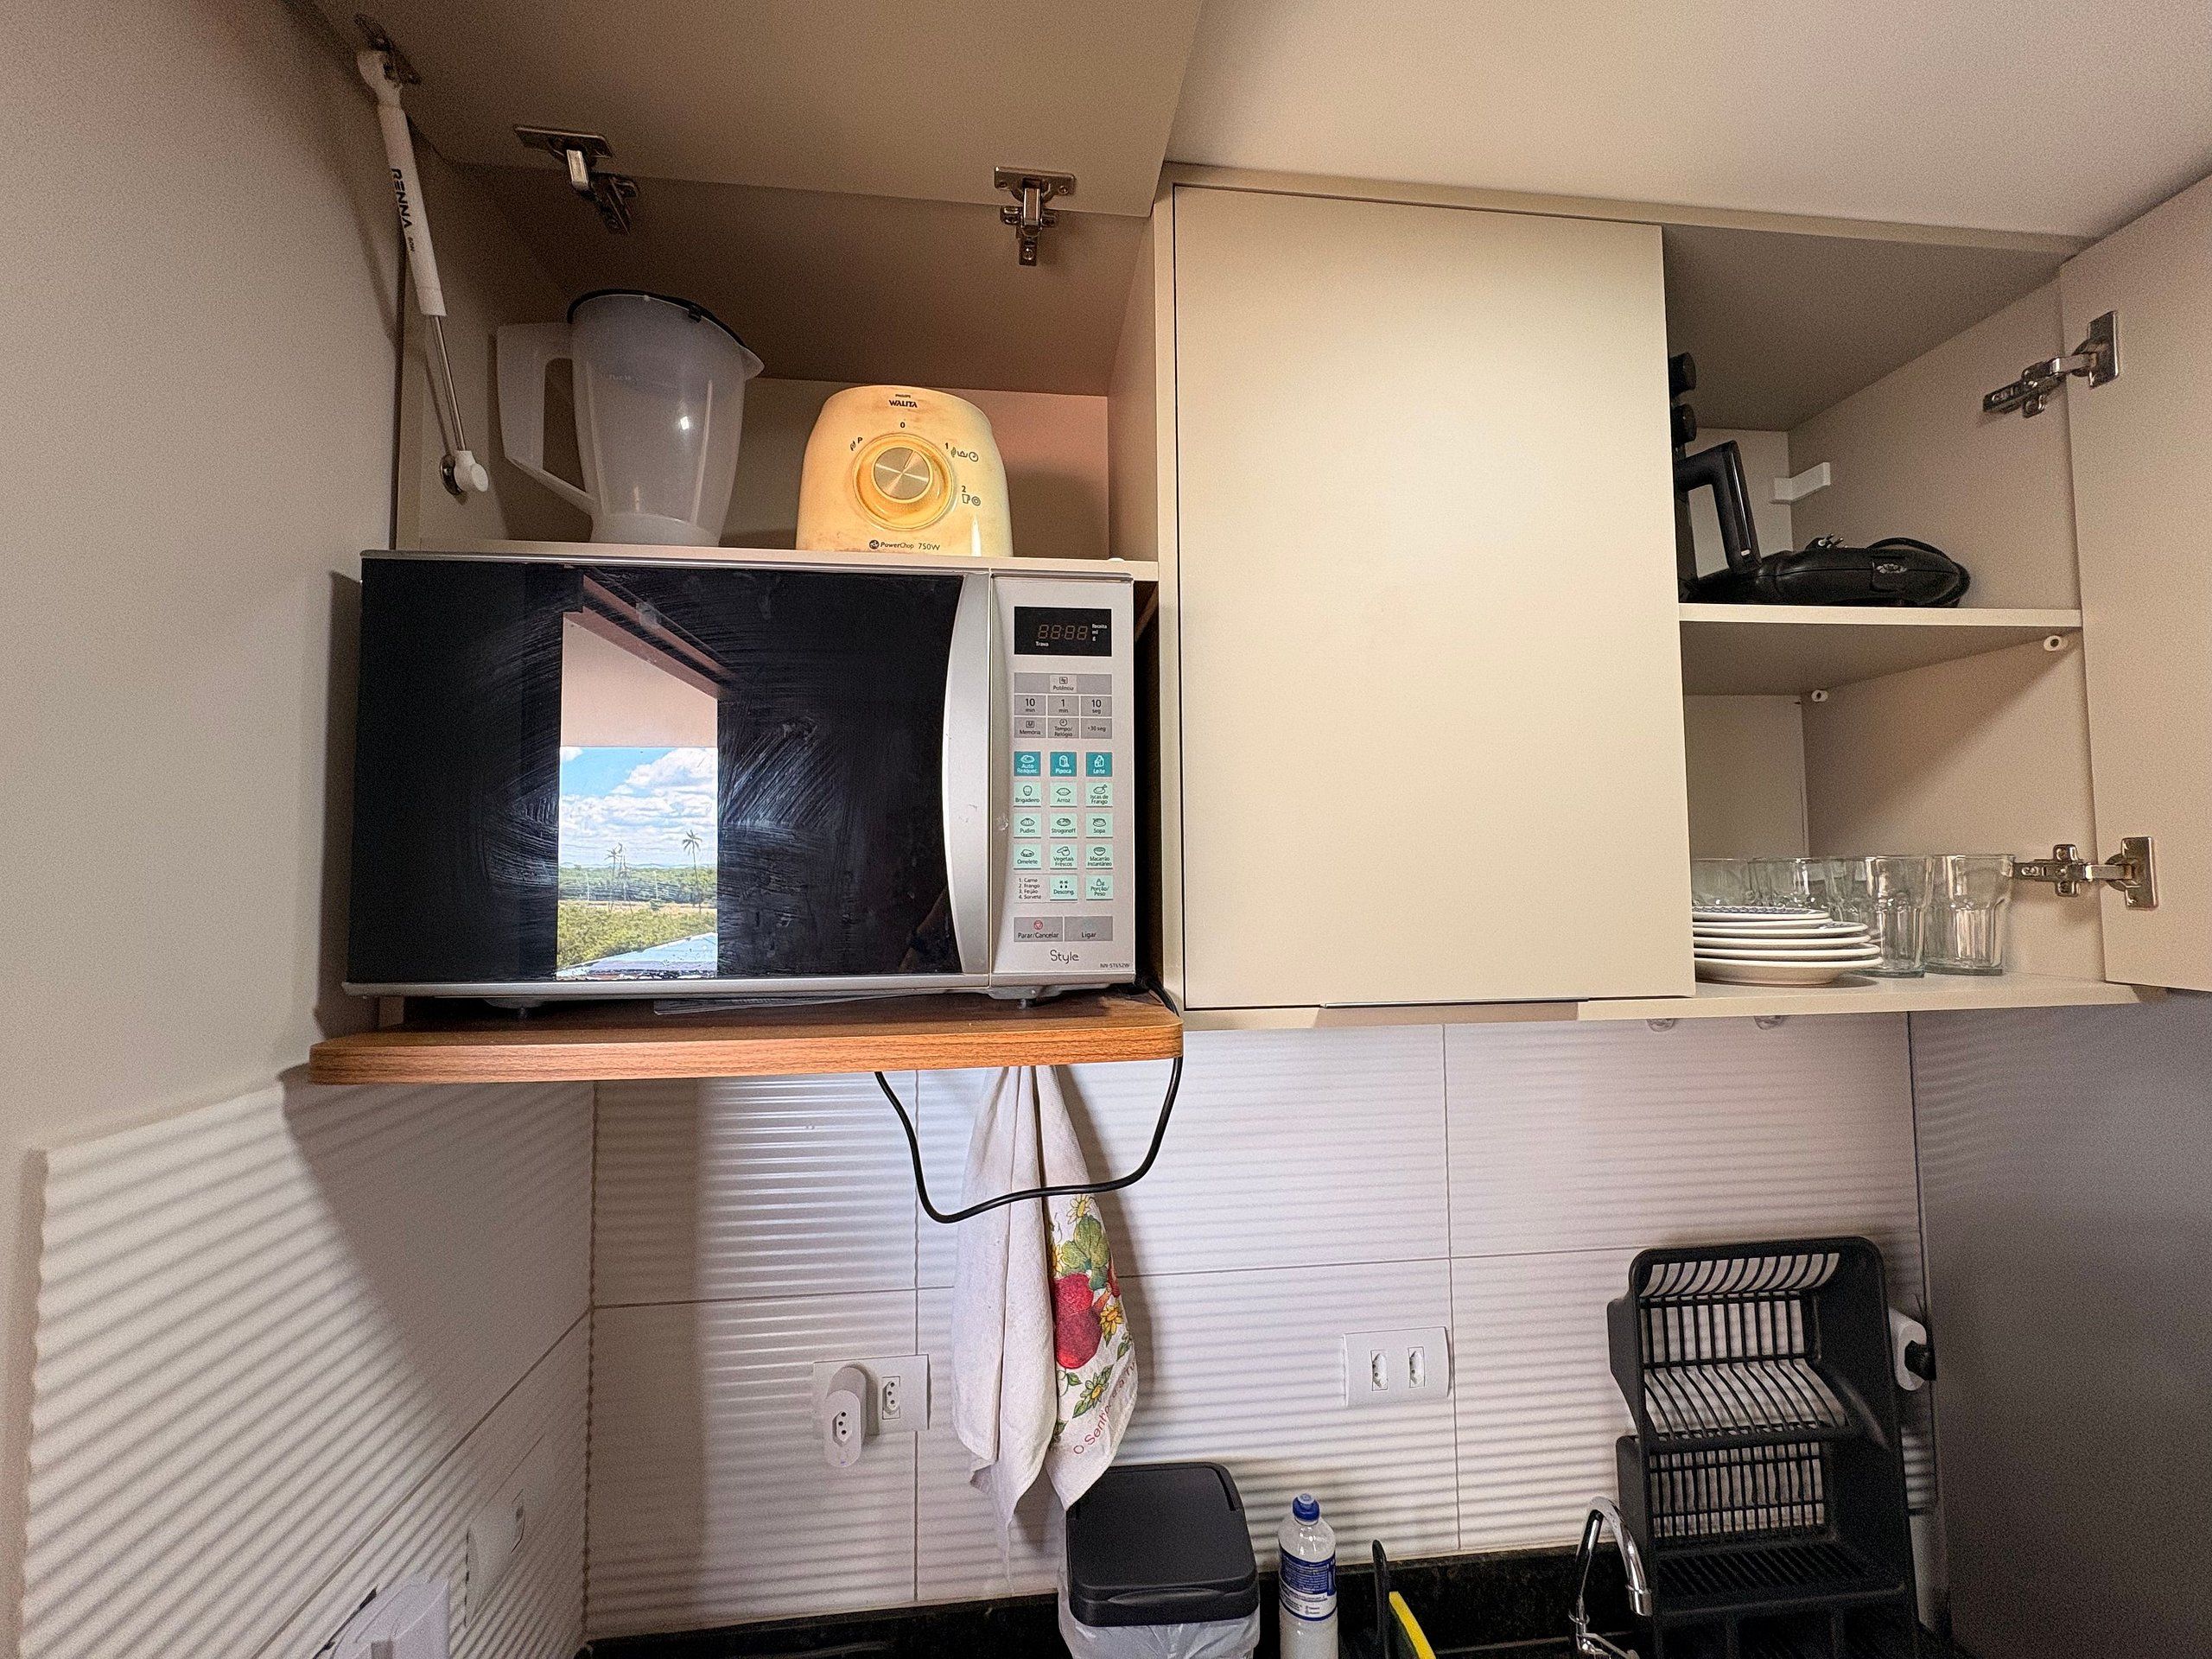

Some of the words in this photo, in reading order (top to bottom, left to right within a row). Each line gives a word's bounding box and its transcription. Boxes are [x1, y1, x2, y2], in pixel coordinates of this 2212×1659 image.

[391, 168, 413, 229] RENNA
[888, 399, 918, 408] WALITA
[880, 541, 915, 550] PowerChop
[918, 542, 941, 551] 750W
[1025, 698, 1036, 707] 10
[1091, 699, 1102, 708] 10
[1050, 950, 1080, 964] Style
[1073, 1445, 1084, 1454] O
